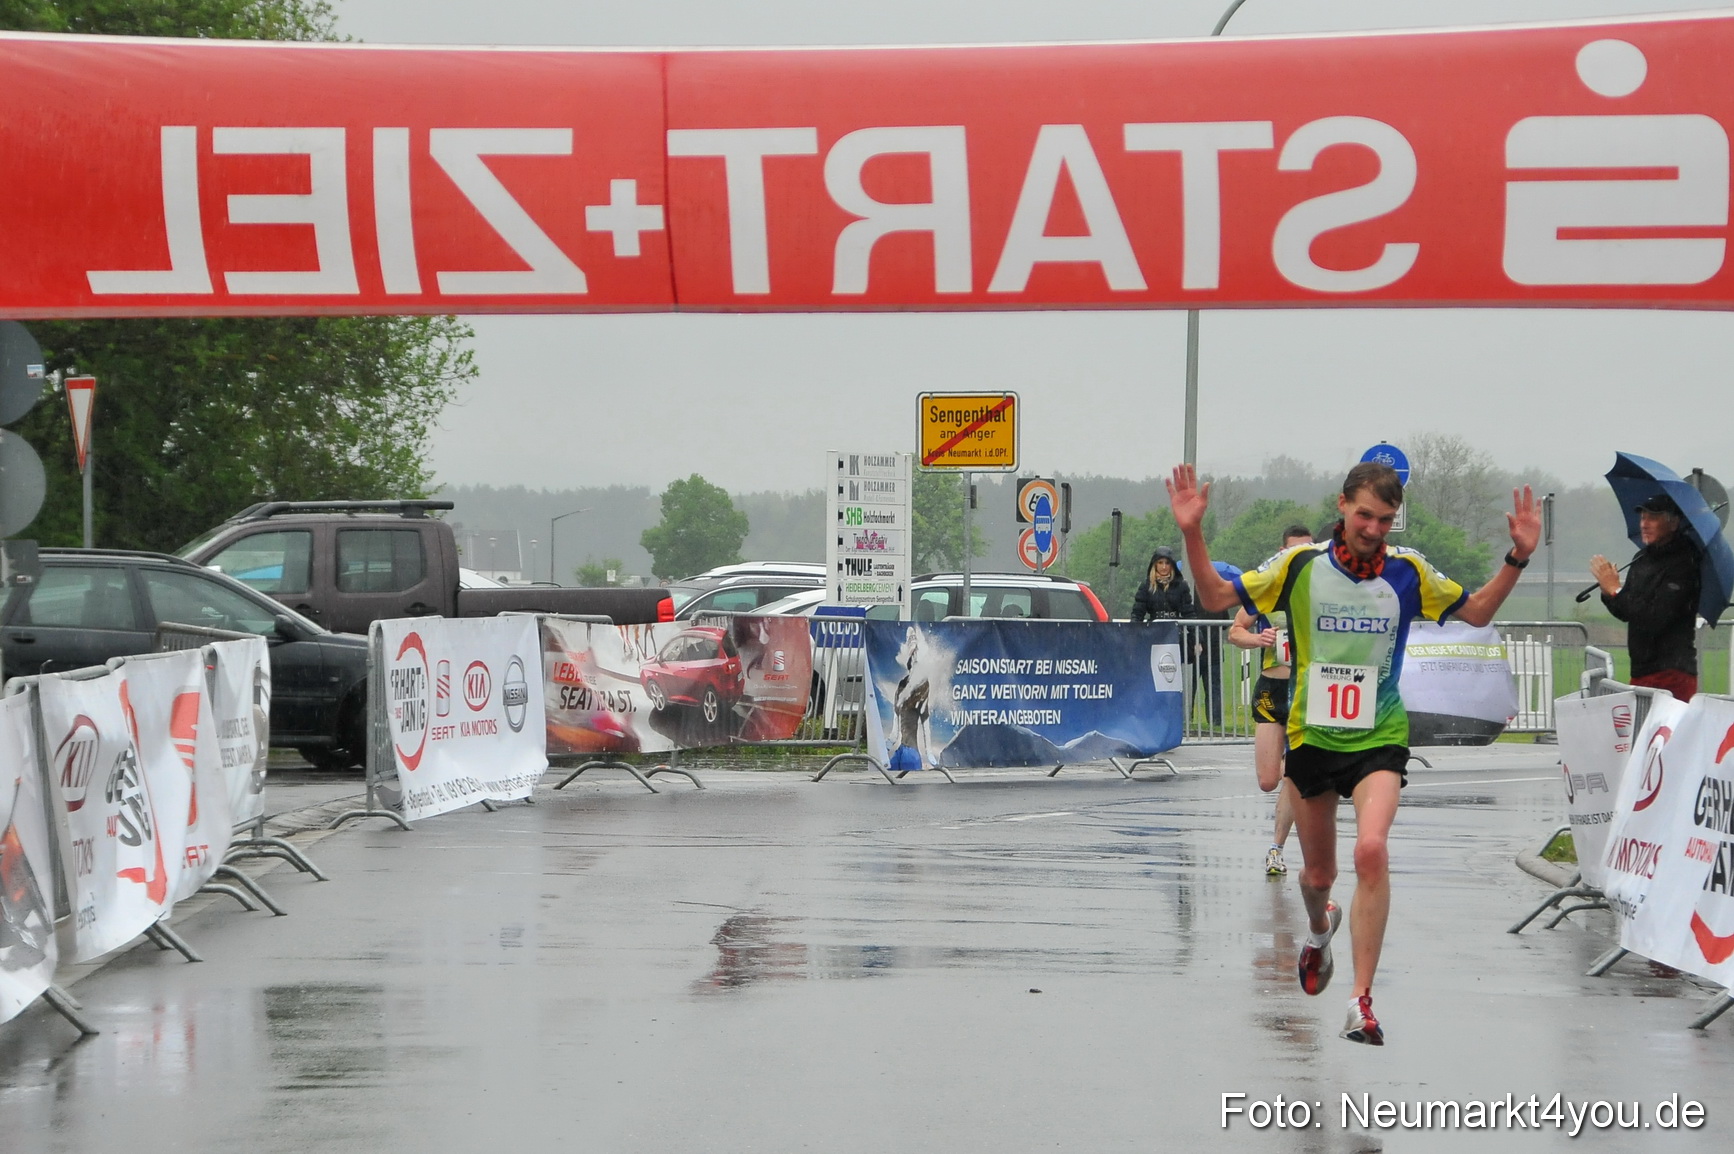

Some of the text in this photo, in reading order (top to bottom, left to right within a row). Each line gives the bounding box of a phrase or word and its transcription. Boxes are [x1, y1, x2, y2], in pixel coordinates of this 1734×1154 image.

[930, 405, 1006, 427] Sengenthal
[940, 428, 996, 441] am Anger
[864, 455, 895, 467] HOLZAMMER
[948, 448, 982, 458] Neumarkt
[864, 481, 895, 492] HOLZAMMER
[846, 507, 862, 526] SHB
[845, 558, 872, 576] THULE
[1320, 602, 1367, 616] TEAM
[821, 621, 859, 635] VOLVO
[1318, 616, 1390, 634] BOCK
[1408, 646, 1426, 656] DER
[1426, 646, 1449, 656] NEUE
[1448, 645, 1478, 656] PICANTO
[955, 658, 1098, 675] SAISONSTART BEI NISSAN:
[1321, 666, 1351, 675] MEYER
[468, 673, 486, 699] KIA
[504, 687, 526, 700] NISSAN
[952, 684, 1113, 700] GANZ WEIT VORN MIT TOLLEN
[617, 689, 637, 713] ST.
[1327, 684, 1361, 720] 10
[400, 699, 425, 733] JANIG
[950, 709, 1061, 726] WINTERANGEBOTEN
[432, 725, 455, 740] SEAT
[460, 719, 497, 737] KIA MOTORS
